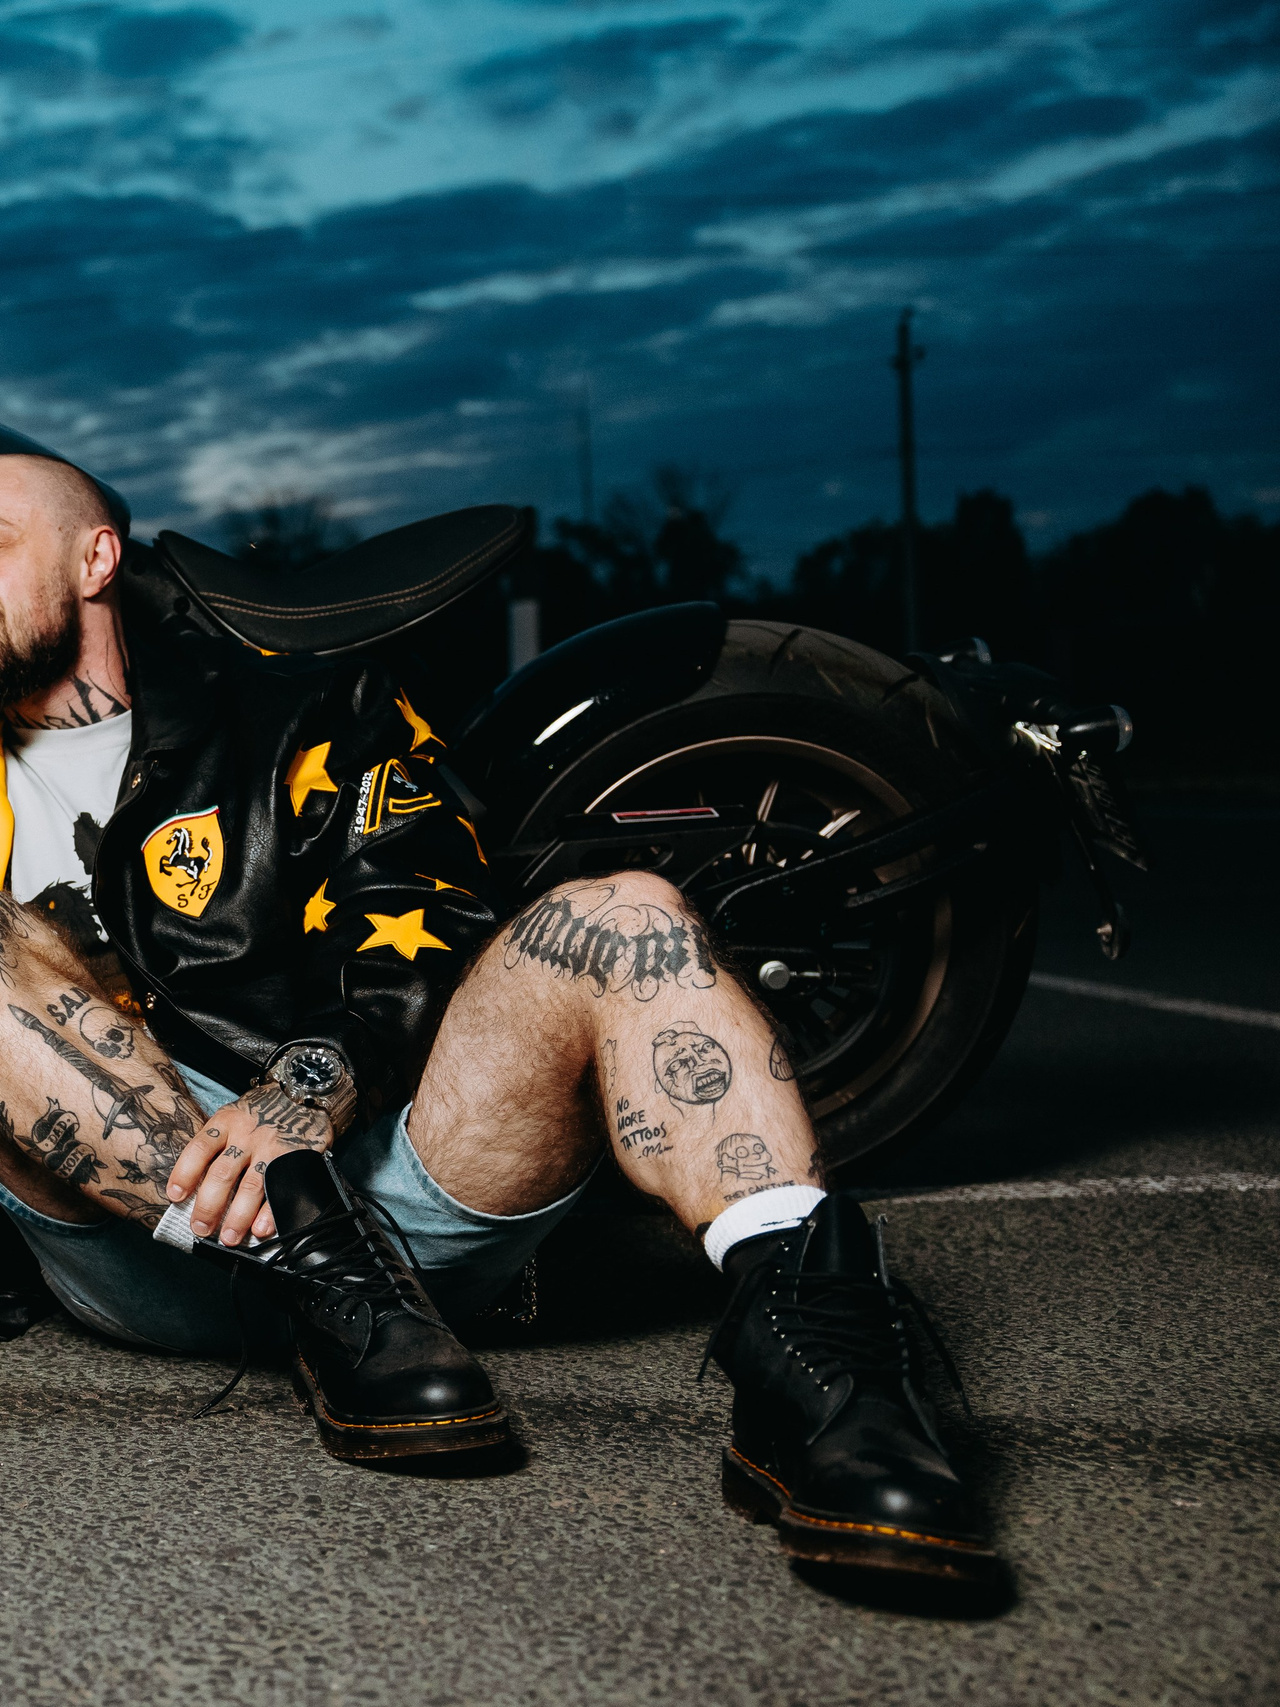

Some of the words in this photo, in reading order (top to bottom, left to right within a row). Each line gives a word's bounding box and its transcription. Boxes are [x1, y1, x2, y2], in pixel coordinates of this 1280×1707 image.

[177, 893, 189, 908] S
[198, 880, 217, 900] F
[46, 987, 91, 1026] SAD
[616, 1096, 630, 1116] NO
[49, 1120, 68, 1144] DAD
[617, 1110, 646, 1134] MORE
[620, 1121, 667, 1151] TATTOOS
[58, 1149, 84, 1176] MOM
[723, 1190, 745, 1202] THEY
